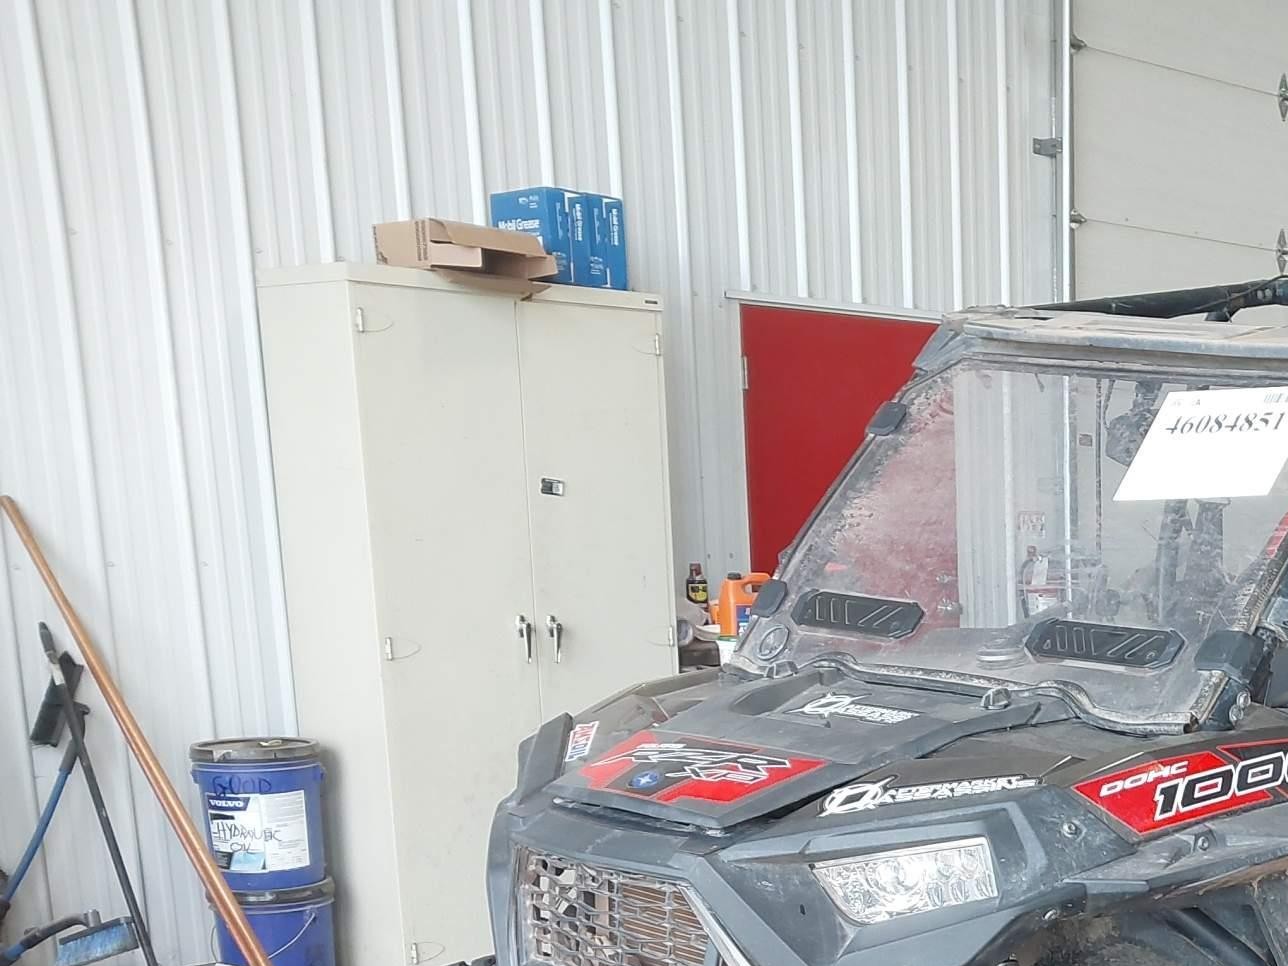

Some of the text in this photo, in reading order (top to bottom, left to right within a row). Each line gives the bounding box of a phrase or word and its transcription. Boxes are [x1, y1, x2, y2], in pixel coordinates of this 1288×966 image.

[516, 218, 541, 230] Grease
[1165, 411, 1287, 435] 46084851
[1100, 761, 1189, 797] DOHC
[208, 799, 244, 807] VOLVO
